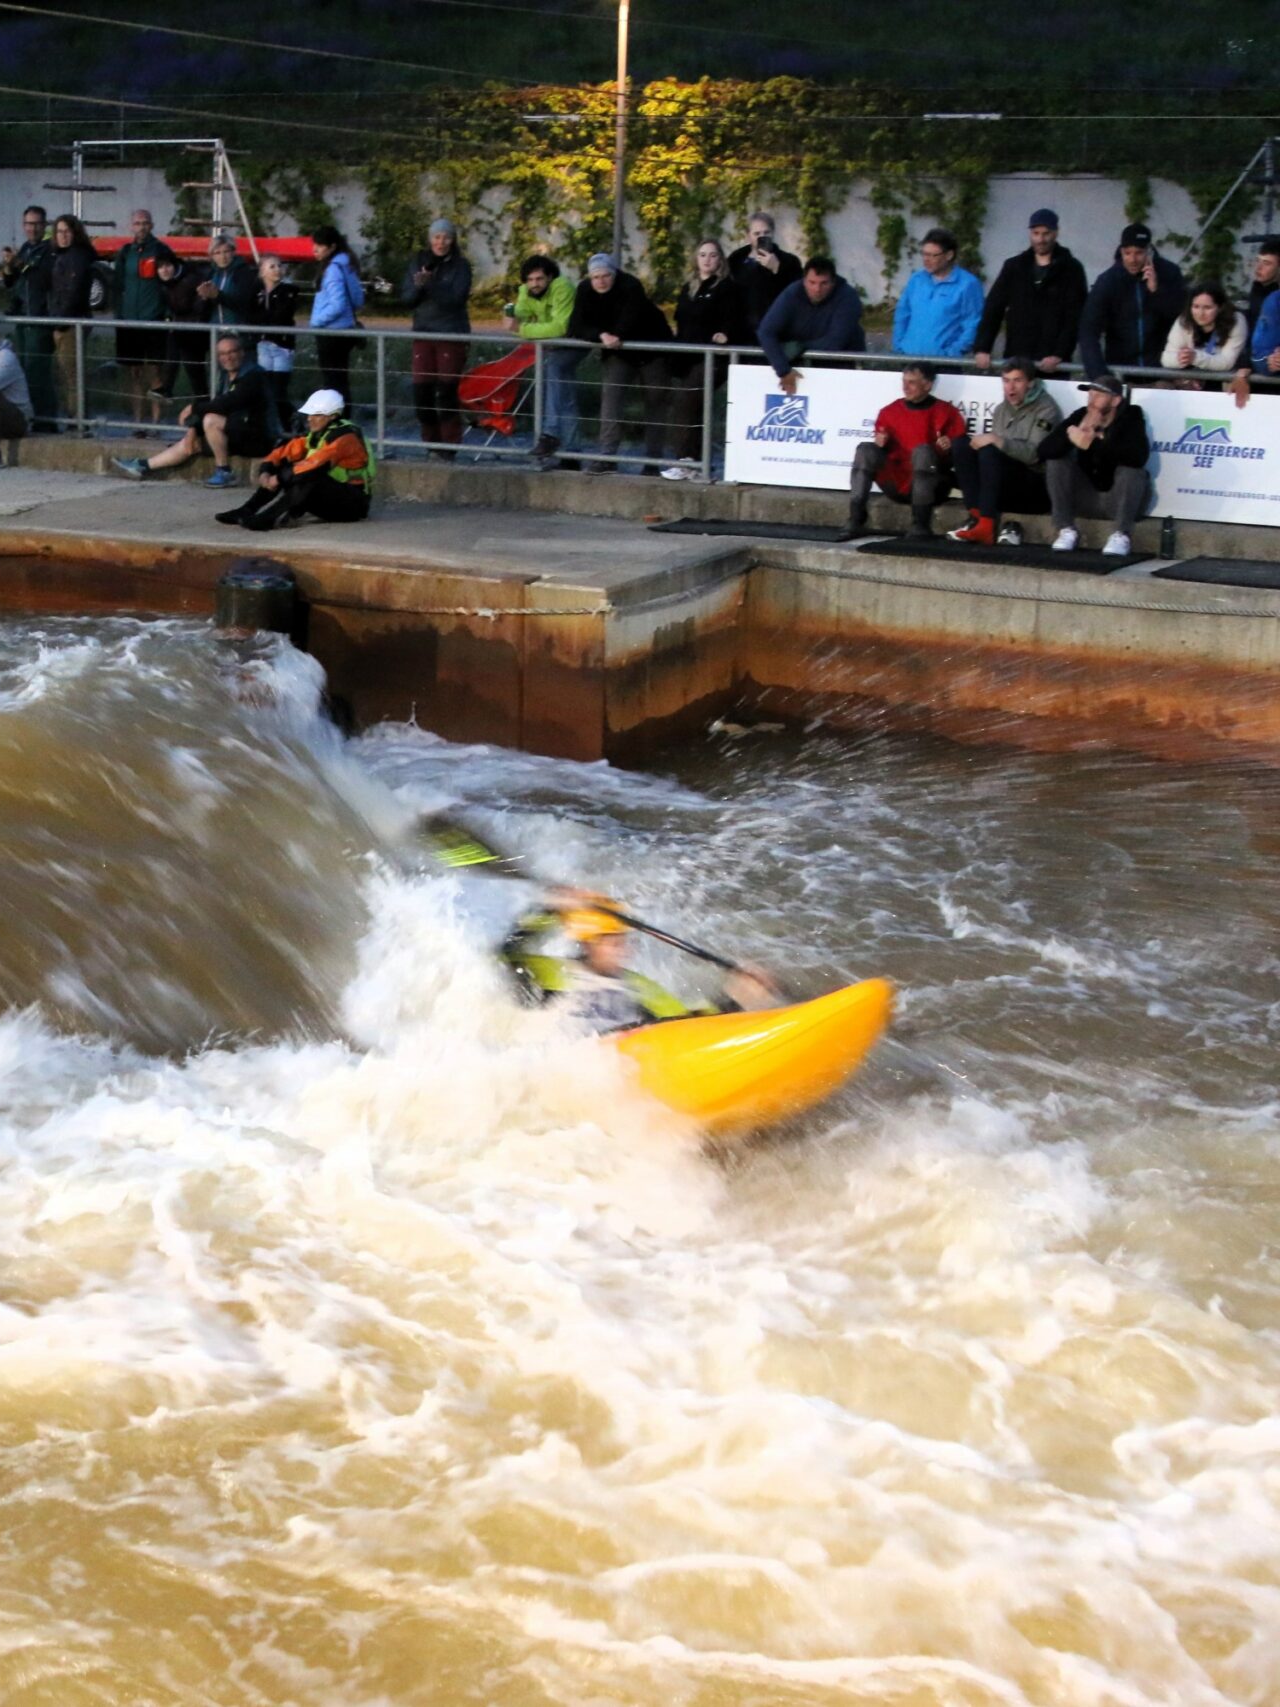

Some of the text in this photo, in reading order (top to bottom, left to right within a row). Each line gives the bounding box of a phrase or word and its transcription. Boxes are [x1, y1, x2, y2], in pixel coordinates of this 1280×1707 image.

[951, 400, 995, 417] ARK
[966, 417, 993, 434] EE
[746, 425, 826, 445] KANUPARK
[1150, 440, 1266, 460] MARKKLEEBERGER
[1192, 456, 1215, 469] SEE
